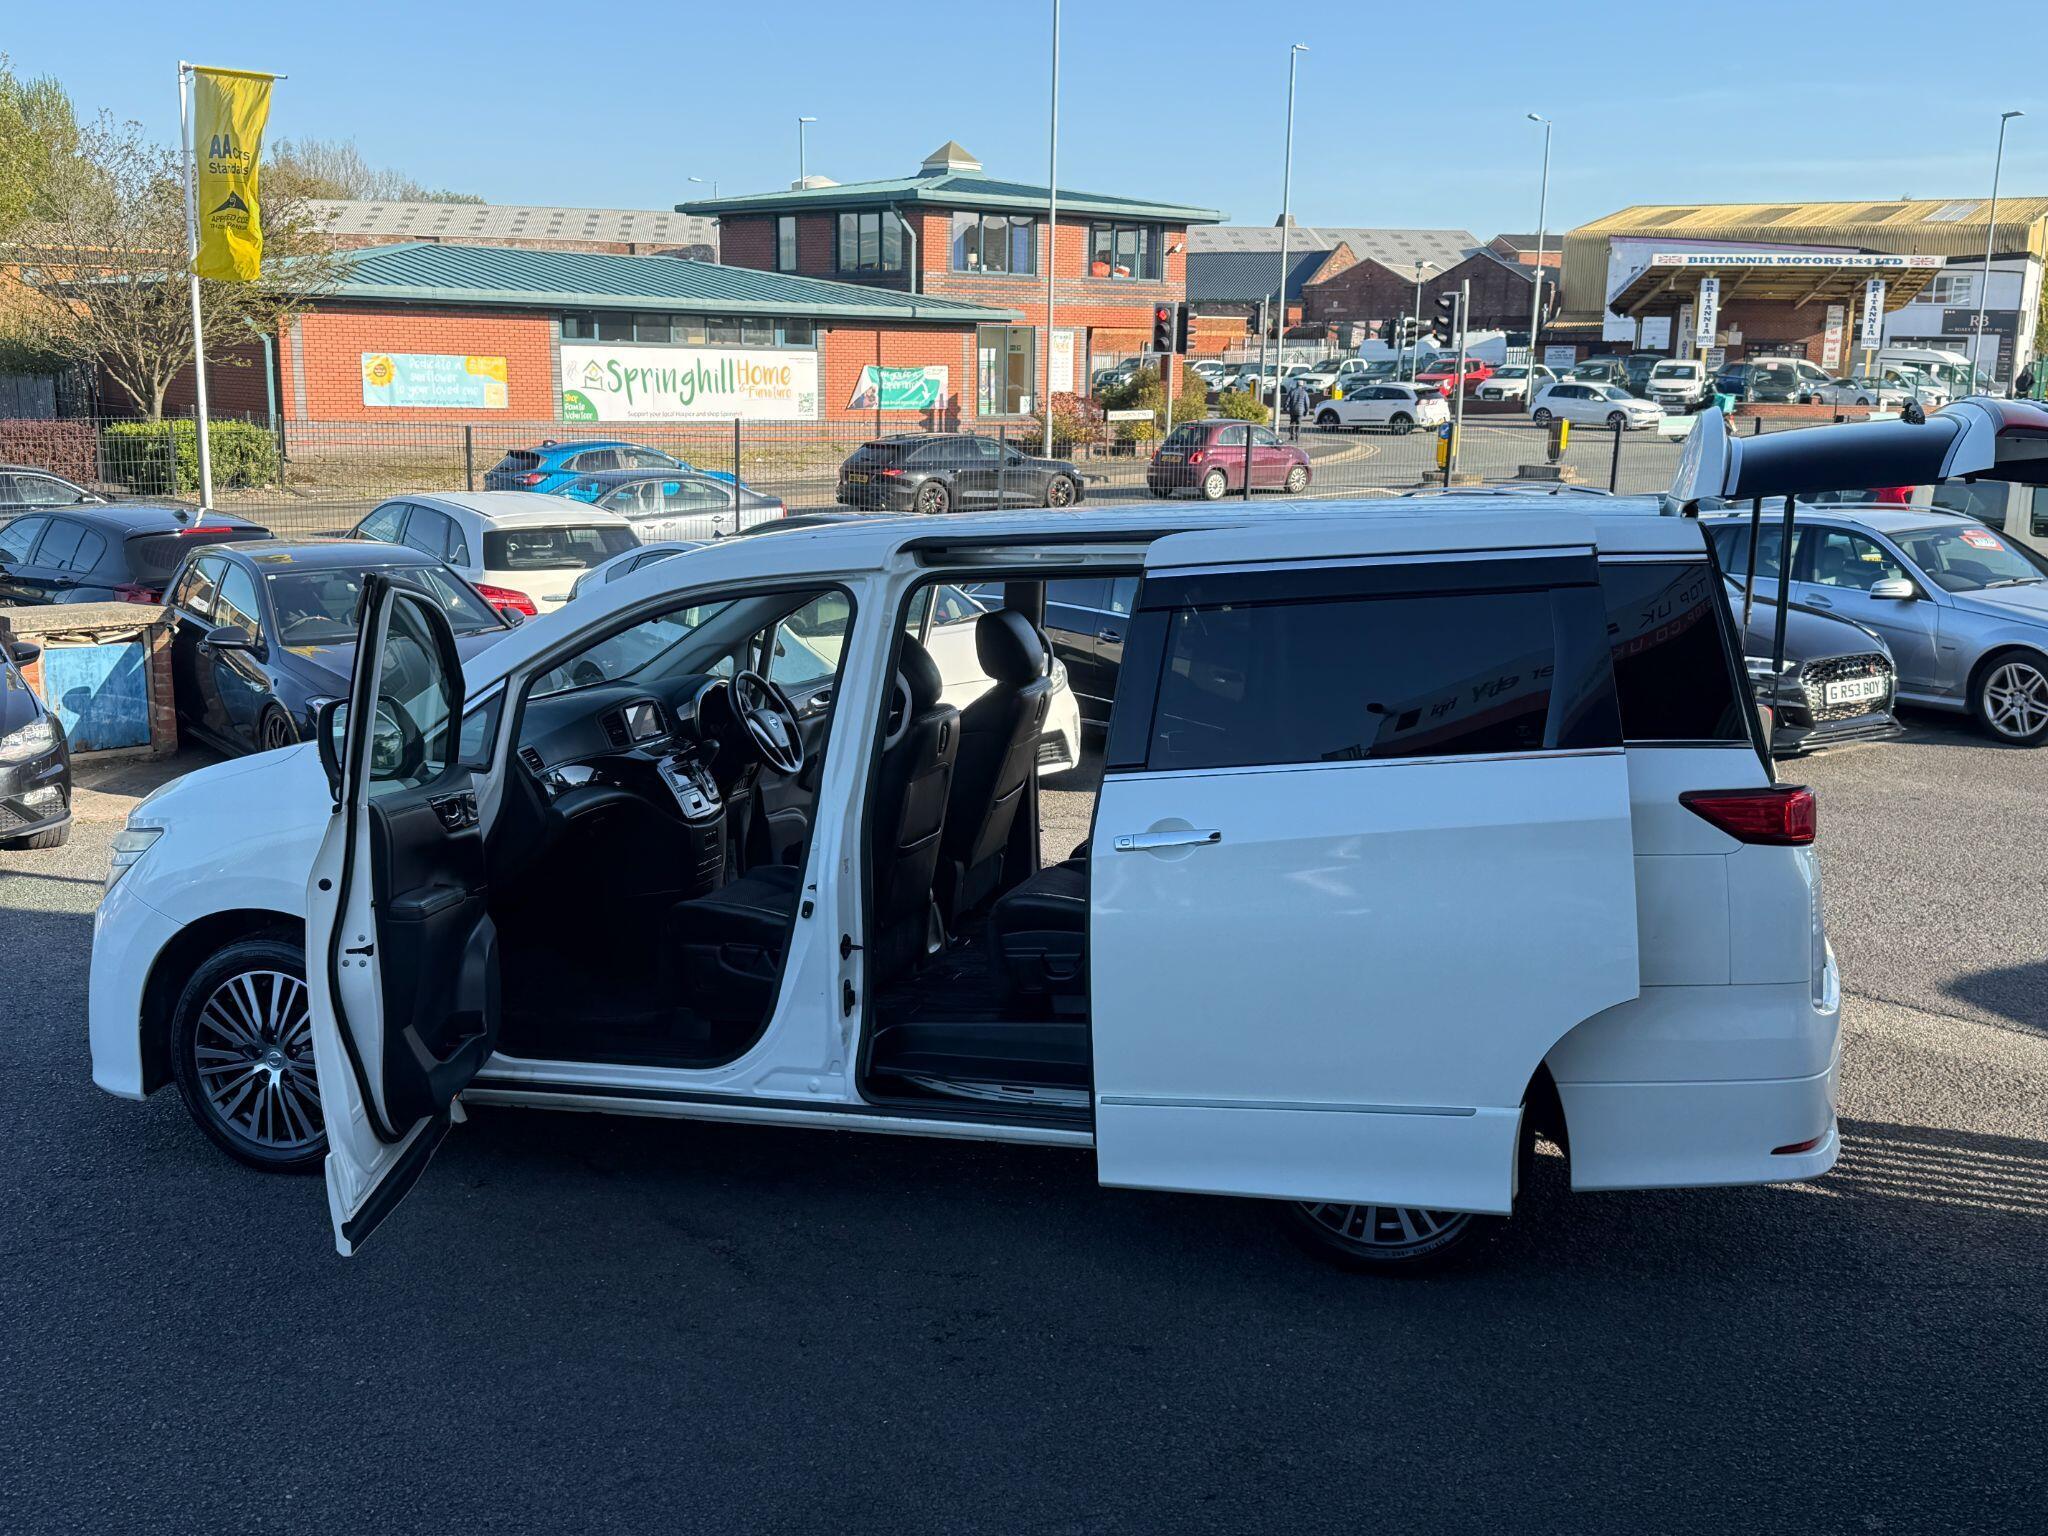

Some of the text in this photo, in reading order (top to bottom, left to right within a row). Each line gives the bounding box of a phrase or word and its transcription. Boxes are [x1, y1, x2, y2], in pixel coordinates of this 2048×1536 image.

[209, 134, 232, 158] AA
[1687, 256, 1904, 266] BRITANNIA MOTORS 4x4 LTD
[1703, 280, 1715, 335] BRITANNIA
[1867, 280, 1880, 336] BRITANNIA
[432, 383, 460, 395] loved
[607, 358, 791, 407] Springhill Home
